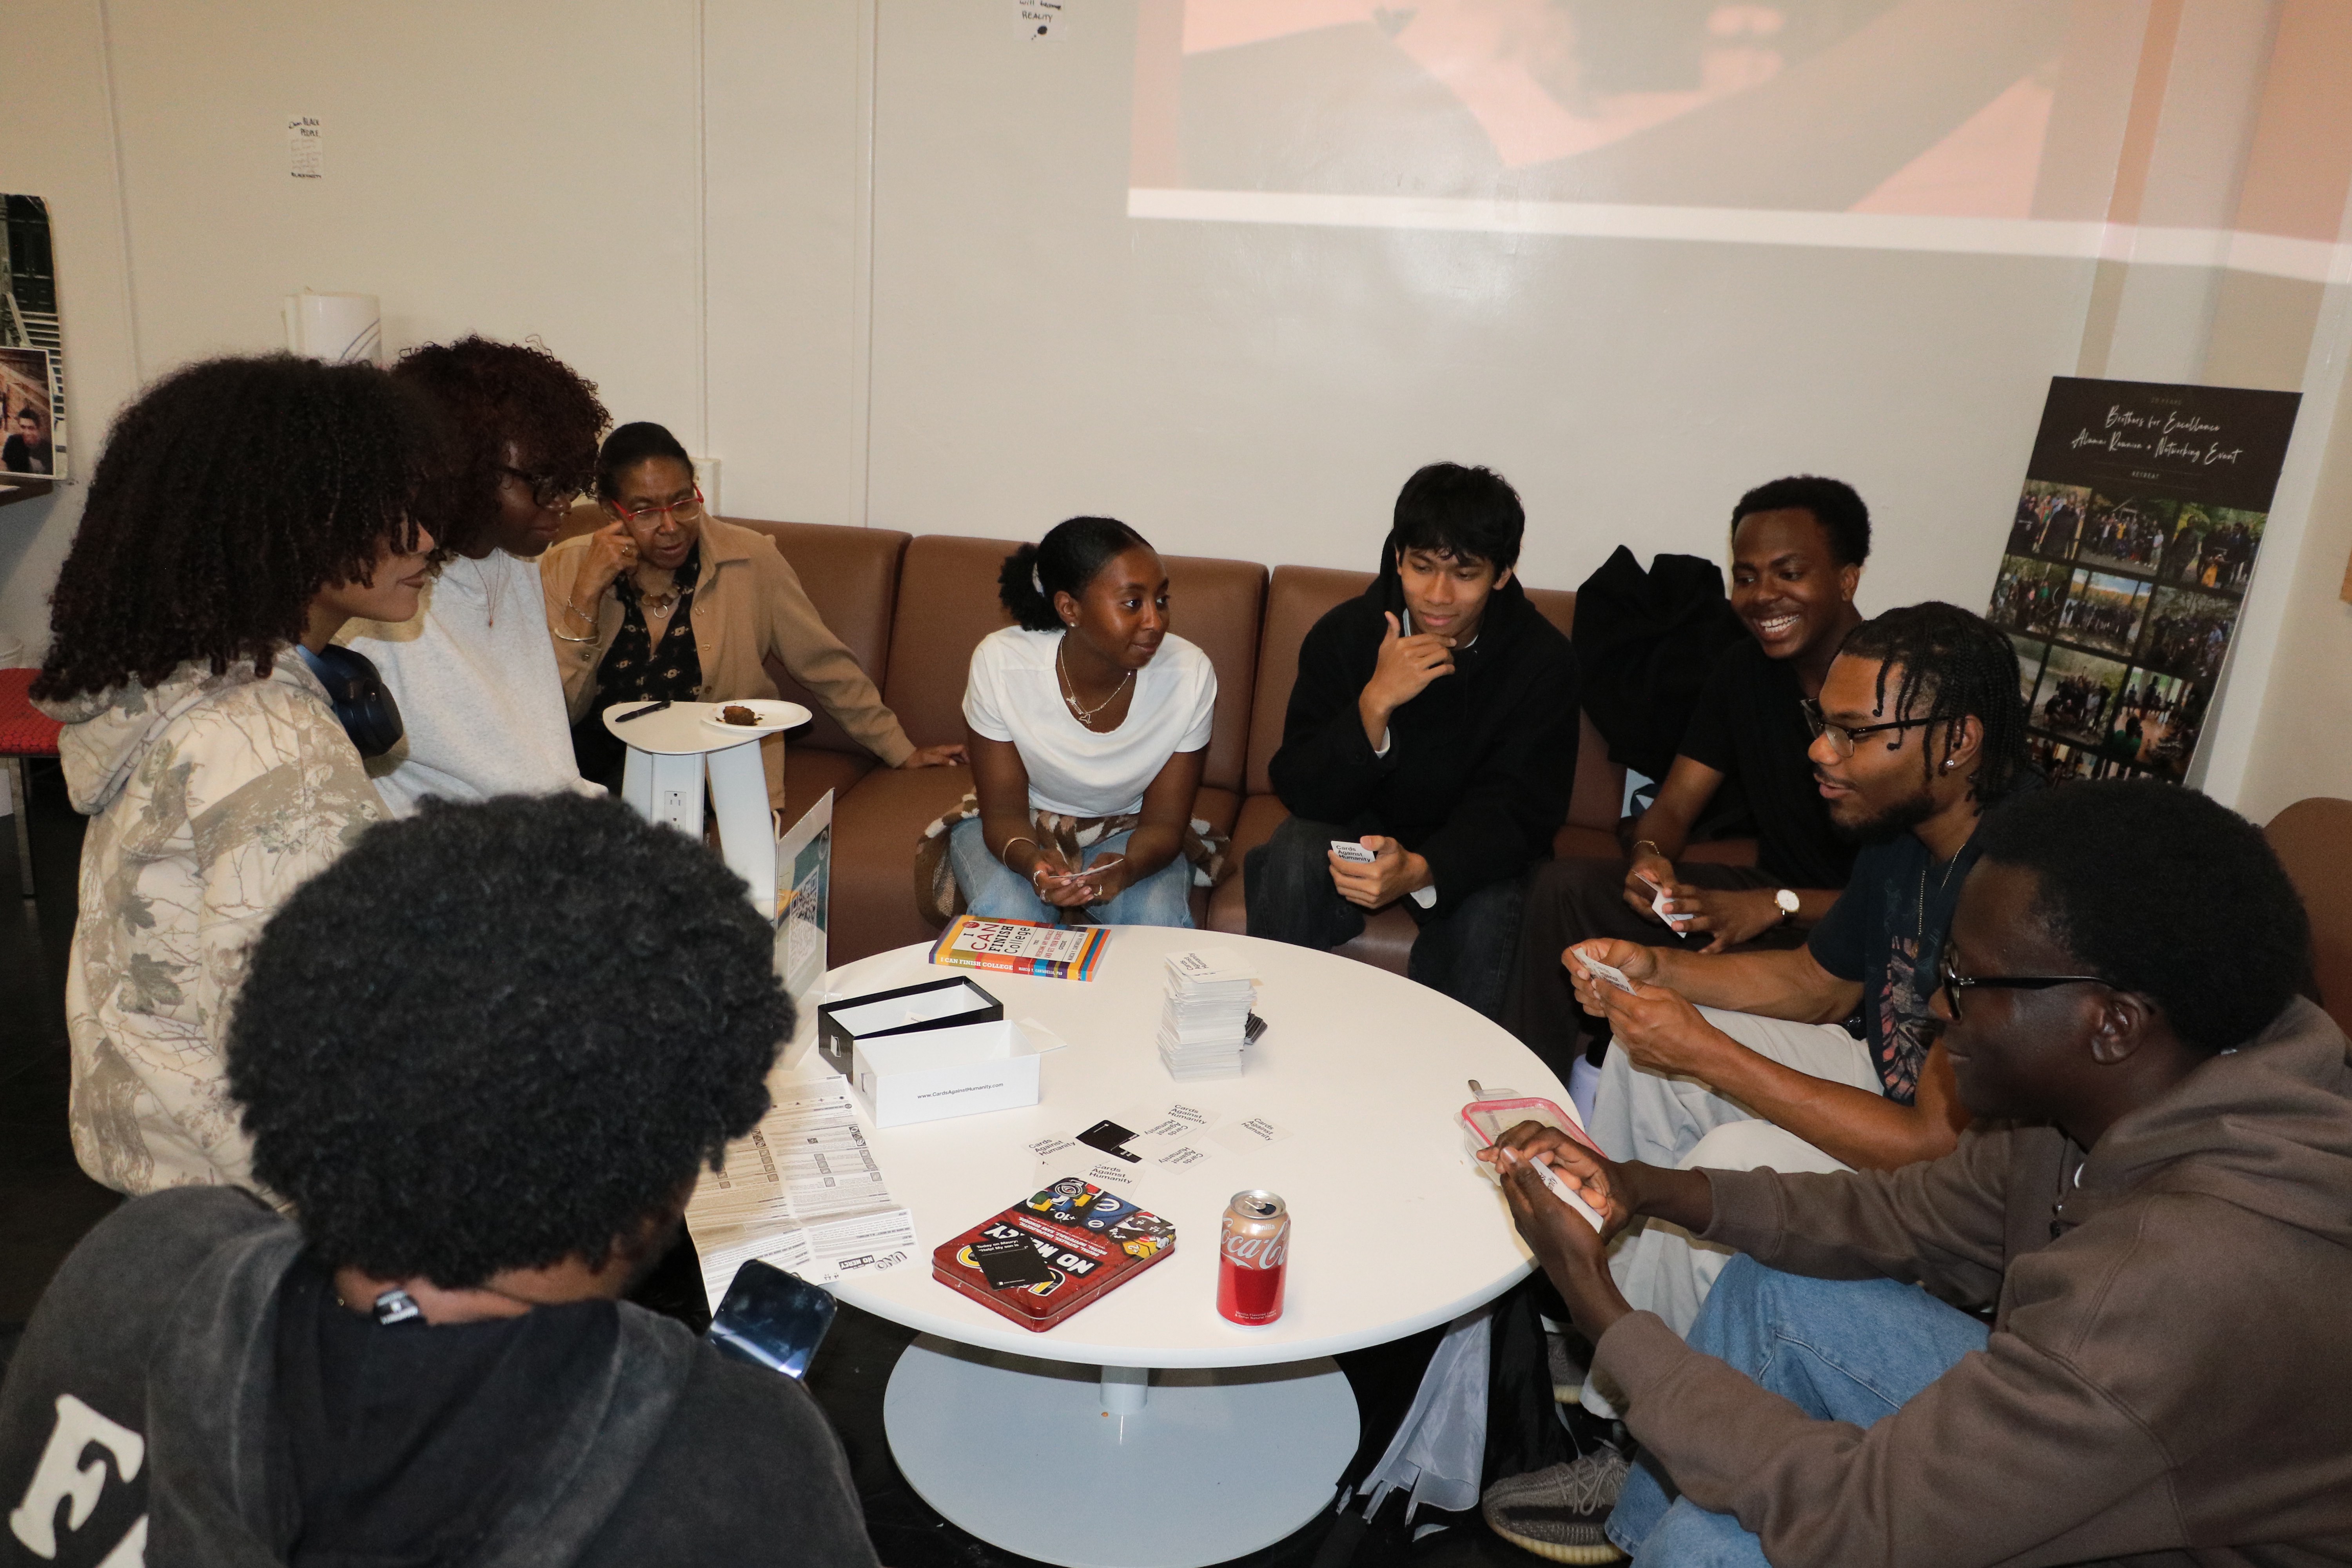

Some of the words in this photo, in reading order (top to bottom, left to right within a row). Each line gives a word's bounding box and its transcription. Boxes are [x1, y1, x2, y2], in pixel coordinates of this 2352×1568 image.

[1022, 10, 1053, 23] REALITY
[2105, 404, 2145, 428] Brothers
[2148, 415, 2161, 428] for
[2162, 411, 2221, 434] Excellence
[2071, 428, 2107, 449] Alumni
[2108, 431, 2143, 452] Reunion
[2154, 436, 2201, 463] Networking
[2203, 442, 2244, 465] Event
[971, 923, 1000, 950] CAN
[988, 926, 1014, 953] FINISH
[1004, 927, 1031, 954] College
[982, 962, 1014, 970] COLLEGE
[1180, 960, 1194, 971] Cards
[917, 1082, 1004, 1099] www.CardsAgainstHumanity.com
[1171, 1108, 1202, 1119] Against
[1174, 1104, 1199, 1114] Cards
[1168, 1111, 1207, 1125] Humanity
[1254, 1118, 1274, 1130] Cards
[1144, 1119, 1176, 1135] Humanity
[1156, 1122, 1181, 1136] Against
[1168, 1125, 1188, 1136] Cards
[1241, 1122, 1273, 1141] Humanity
[1247, 1121, 1273, 1135] Against
[1029, 1139, 1052, 1149] Cards
[1035, 1140, 1064, 1152] Against
[1039, 1142, 1076, 1156] Humanity
[1158, 1147, 1191, 1164] Humanity
[1171, 1150, 1196, 1164] Against
[1183, 1153, 1203, 1164] Cards
[1089, 1172, 1133, 1184] Humanity
[1091, 1168, 1126, 1178] Against
[1054, 1212, 1076, 1221] +10
[984, 1225, 1059, 1258] MECY
[1080, 1247, 1100, 1257] BRUTAL.
[1088, 1245, 1108, 1255] BRUTAL.
[840, 1258, 862, 1270] MERCY
[862, 1255, 874, 1264] NO
[875, 1251, 908, 1271] UNO
[1056, 1253, 1095, 1274] NO
